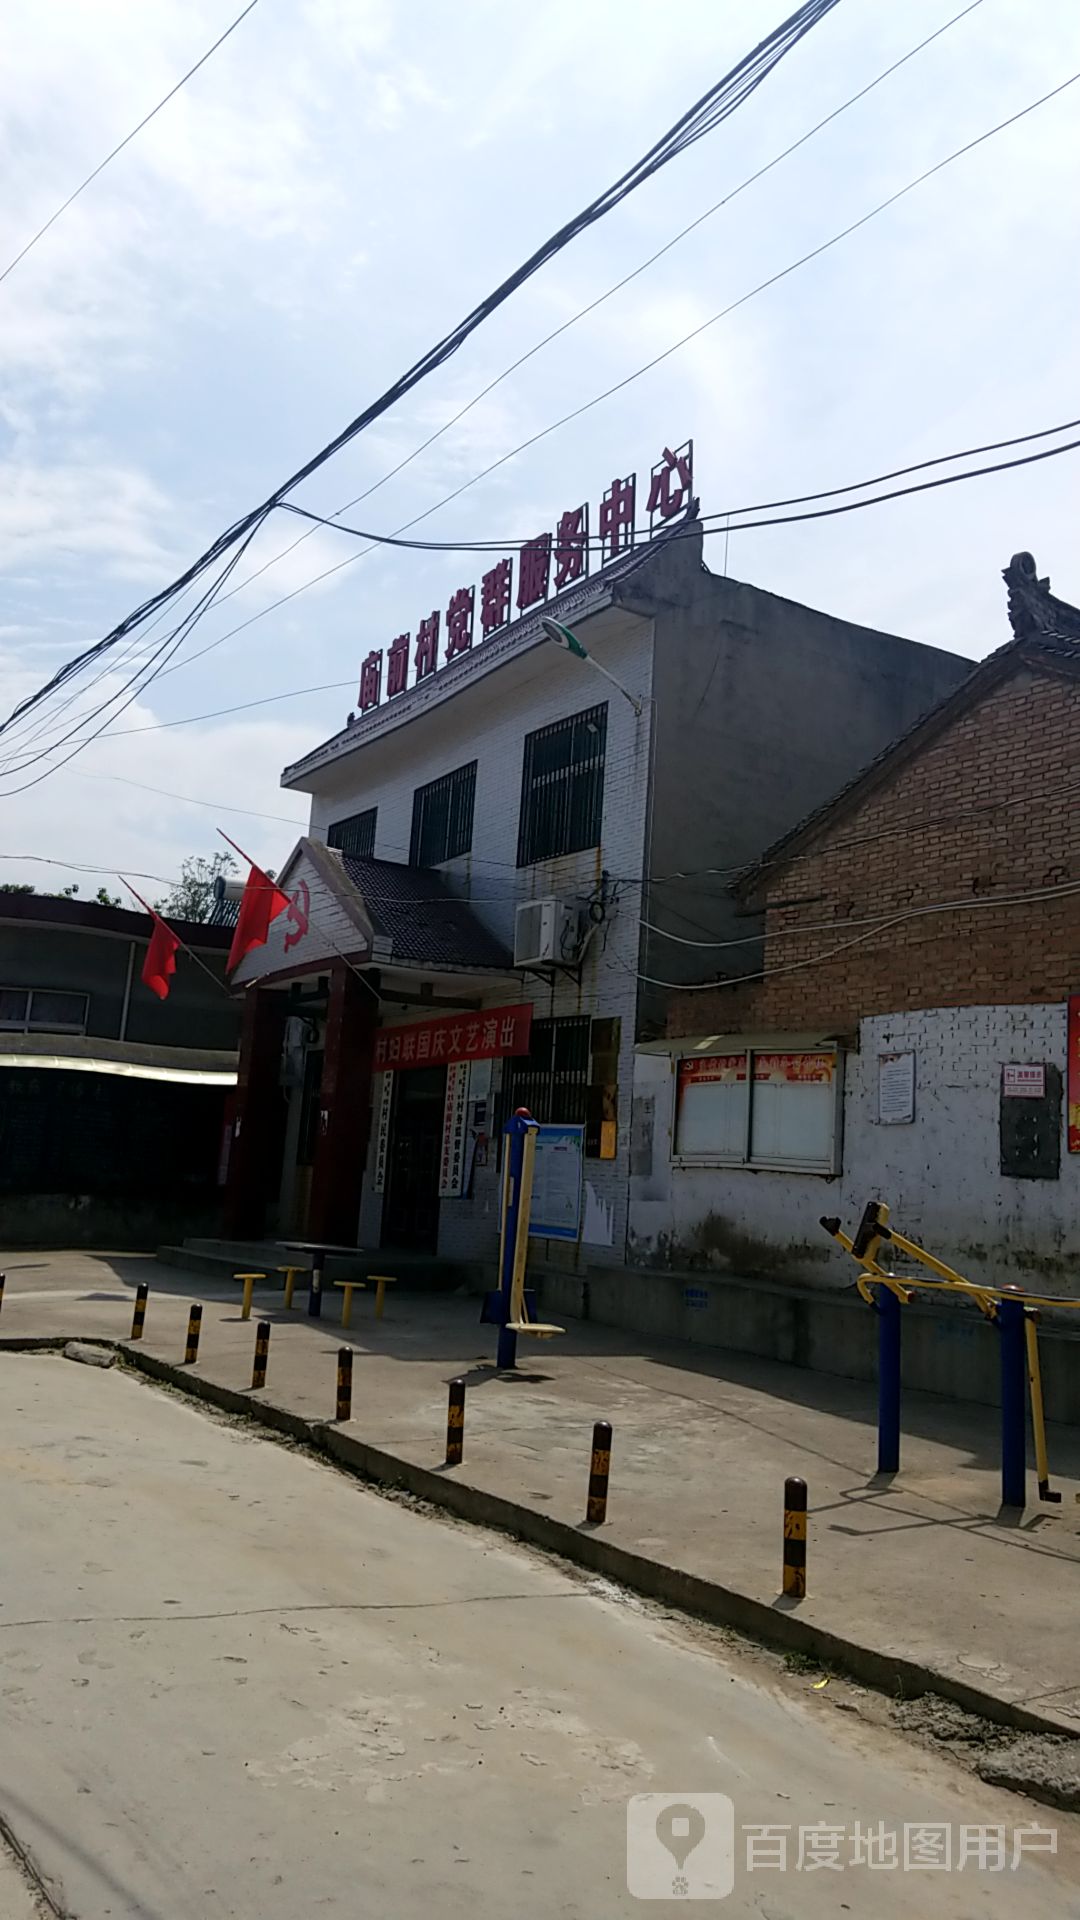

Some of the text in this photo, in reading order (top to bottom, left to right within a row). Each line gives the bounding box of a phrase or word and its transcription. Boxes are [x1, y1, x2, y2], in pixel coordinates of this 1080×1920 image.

[358, 446, 692, 710] 庙前村党群服务中心
[376, 1015, 516, 1064] 村妇联国庆文艺演出
